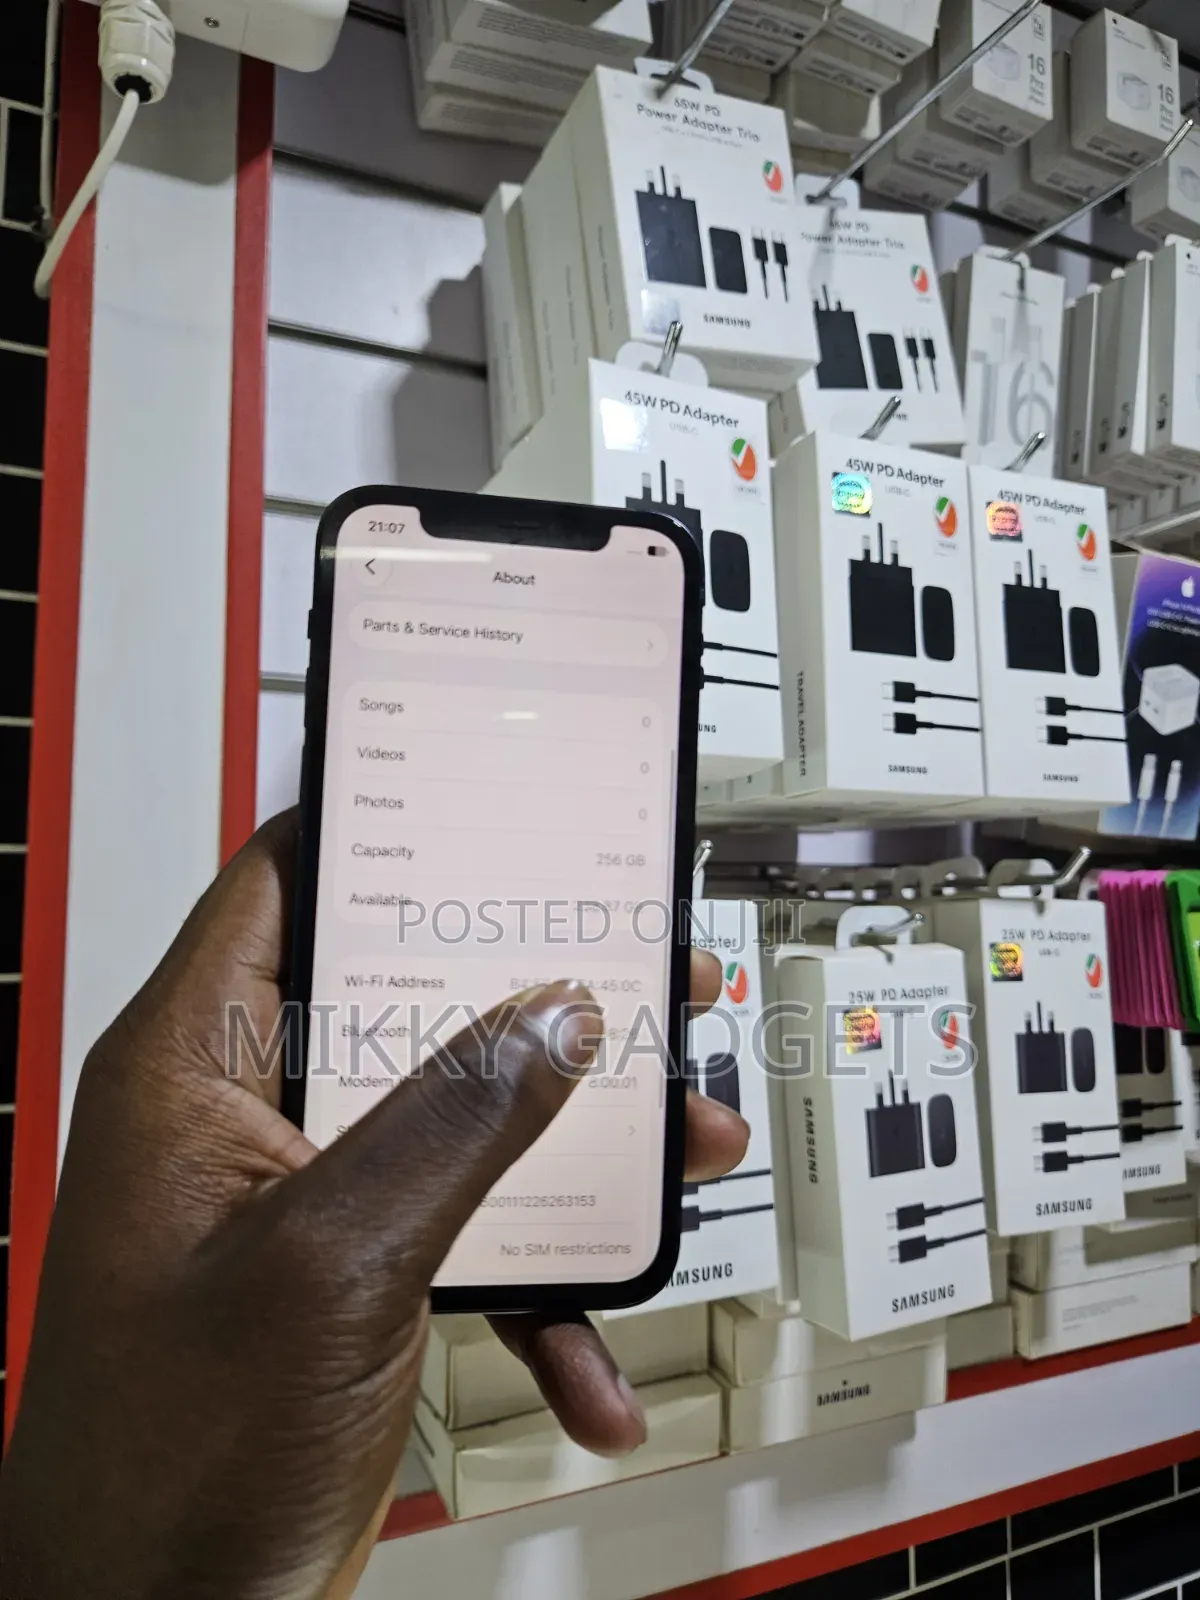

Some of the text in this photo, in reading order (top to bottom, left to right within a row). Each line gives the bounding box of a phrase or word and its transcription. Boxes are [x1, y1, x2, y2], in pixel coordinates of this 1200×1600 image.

[1027, 53, 1046, 76] 16
[1156, 84, 1174, 105] 16
[636, 103, 678, 122] Power
[682, 114, 733, 135] Adapter
[703, 314, 752, 329] SAMSUNG
[624, 390, 739, 428] 45W PD Adapter
[846, 458, 946, 489] 45W PD Adapter
[997, 489, 1087, 516] 45W PD Adapter
[368, 520, 406, 534] 21:07
[493, 571, 536, 587] About
[363, 618, 524, 644] Parts & Service History
[359, 698, 405, 714] Songs
[357, 746, 406, 762] Videos
[887, 764, 928, 775] SAMSUNG
[1043, 773, 1079, 783] SAMSUNG
[354, 794, 405, 810] Photos
[351, 843, 415, 860] Capacity
[349, 892, 412, 908] Available
[690, 936, 737, 950] dapter
[1001, 928, 1092, 943] 25W PD Adapter
[344, 975, 384, 989] Wi-Fi
[387, 976, 446, 990] Address
[848, 984, 949, 1004] 25W PD Adapter
[341, 1024, 412, 1038] Bluetooth
[339, 1075, 395, 1088] Modem
[802, 1096, 819, 1184] SAMSUNG
[1122, 1163, 1161, 1180] AMSUNG
[1035, 1198, 1093, 1216] SAMSUNG
[500, 1241, 633, 1257] No SIM restrictions
[665, 1262, 734, 1288] AMSUNG
[891, 1284, 957, 1314] SAMSUNG
[816, 1383, 872, 1407] SAMSUNG
